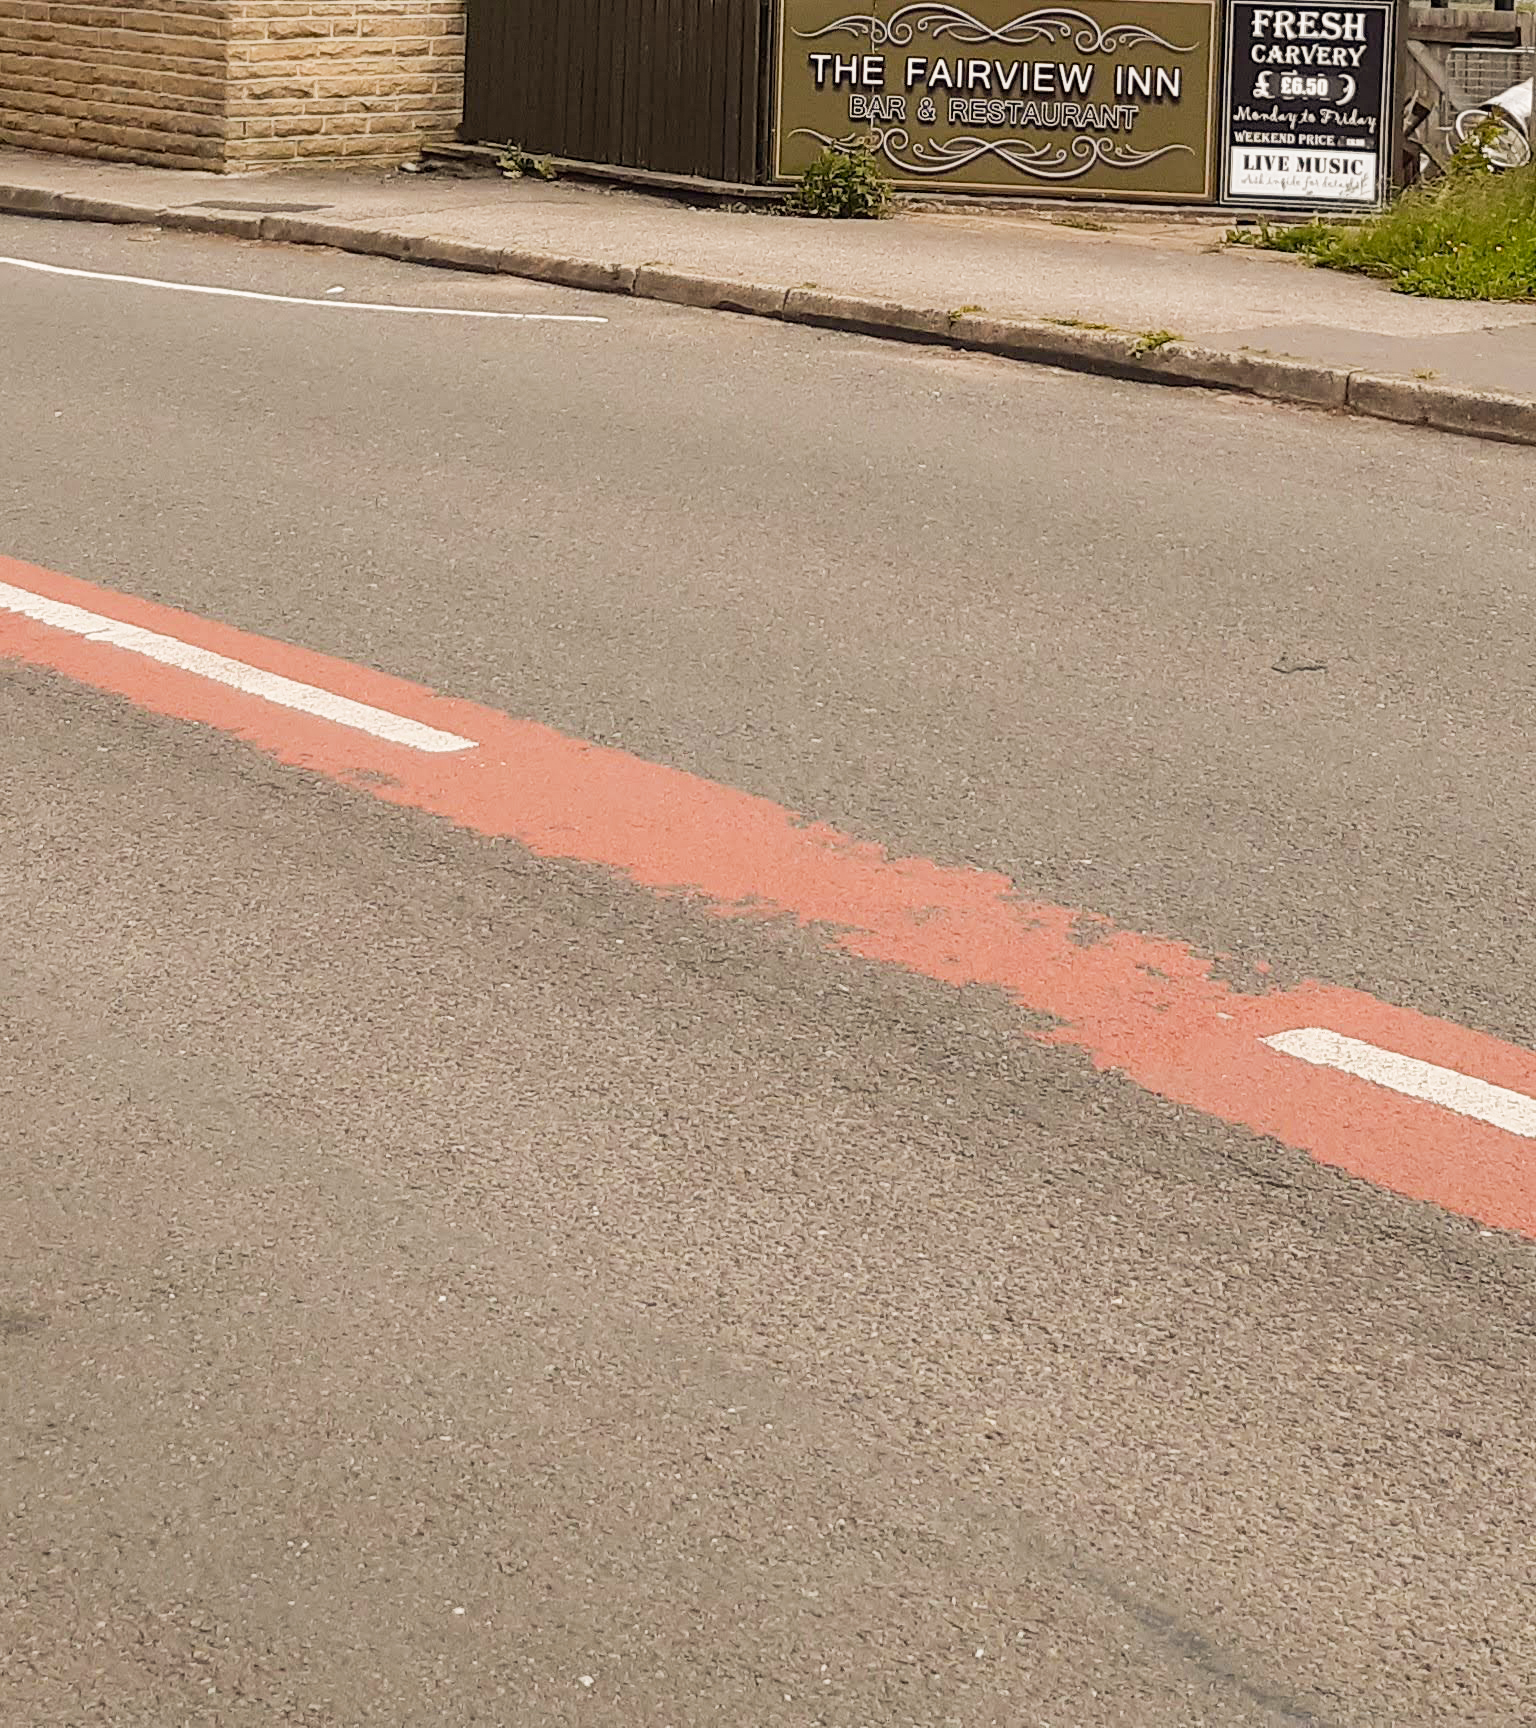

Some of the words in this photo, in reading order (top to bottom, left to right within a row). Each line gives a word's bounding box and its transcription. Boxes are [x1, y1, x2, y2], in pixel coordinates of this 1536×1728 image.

[1251, 9, 1367, 42] FRESH
[1251, 43, 1368, 68] CARVERY
[809, 53, 885, 86] THE
[906, 57, 1094, 94] FAIRVIEW
[1115, 66, 1181, 98] INN
[1280, 76, 1329, 97] £6.50
[849, 94, 906, 120] BAR
[917, 98, 936, 120] &
[949, 98, 1139, 130] RESTAURANT
[1232, 104, 1297, 130] Monday
[1298, 108, 1317, 124] to
[1319, 108, 1377, 134] Friday
[1233, 130, 1296, 145] WEEKEND
[1298, 133, 1335, 147] PRICE
[1242, 154, 1290, 172] LIVE
[1296, 156, 1364, 176] MUSIC
